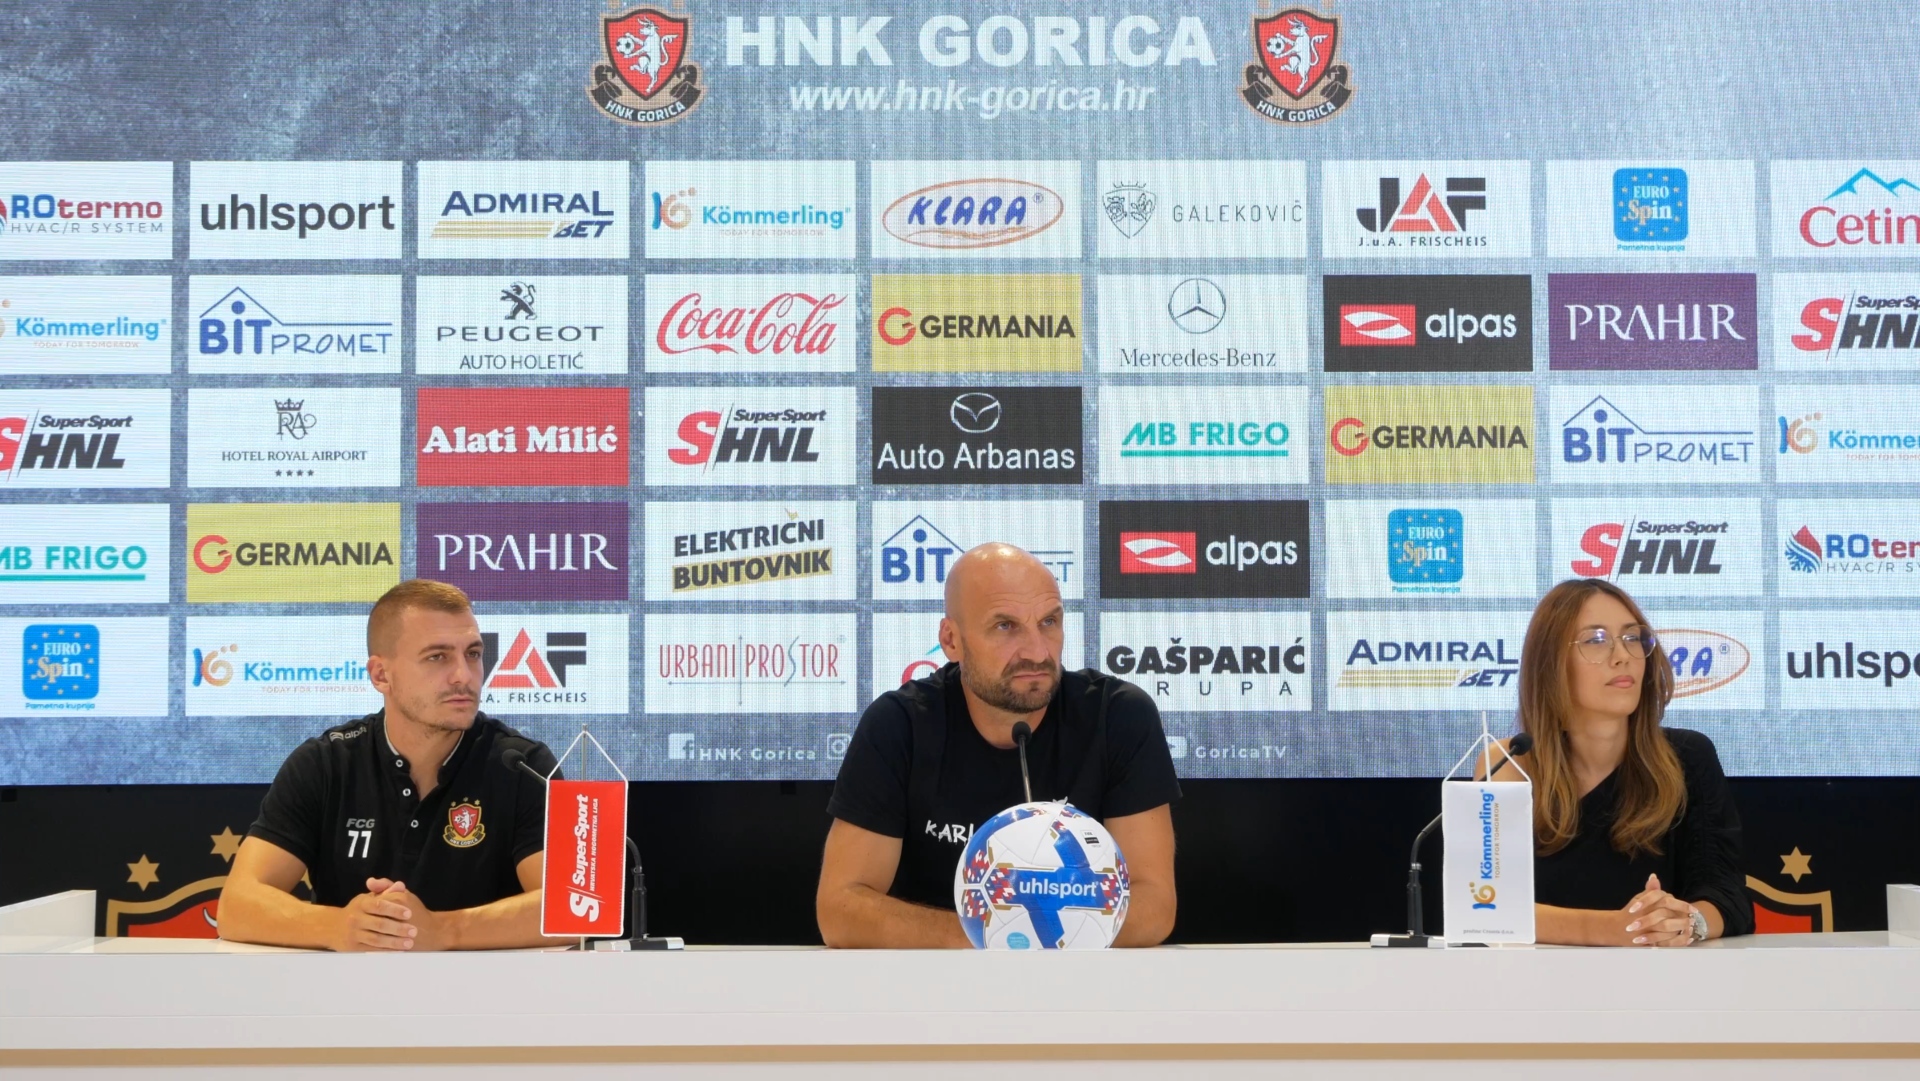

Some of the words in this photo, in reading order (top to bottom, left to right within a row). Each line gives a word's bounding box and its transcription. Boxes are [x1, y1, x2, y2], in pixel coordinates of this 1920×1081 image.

[726, 16, 894, 66] HNK
[919, 14, 1218, 67] GORICA
[604, 100, 635, 121] HNK
[637, 101, 686, 122] GORICA
[790, 79, 1156, 120] www.hnk-gorica.hr
[1256, 100, 1285, 120] HNK
[1288, 101, 1336, 122] GORICA
[441, 190, 615, 217] ADMIRAL
[1633, 185, 1670, 199] EURO
[11, 194, 162, 219] ROtermo
[201, 194, 395, 239] uhlsport
[702, 205, 844, 229] Kömmerling
[1627, 199, 1673, 226] Spin
[11, 222, 81, 234] HVAC/R
[91, 222, 163, 233] SYSTEM
[553, 220, 614, 238] BET
[1410, 236, 1487, 247] FRISCHEIS
[16, 317, 159, 340] Kömmerling
[437, 326, 604, 341] PEUGEOT
[919, 314, 1077, 338] GERMANIA
[1425, 308, 1517, 343] alpas
[1564, 303, 1746, 341] PRAHIR
[1838, 314, 1920, 349] HN
[460, 355, 507, 370] AUTO
[511, 351, 583, 370] HOLETIĆ
[1119, 348, 1276, 367] Mercedes-Benz
[39, 415, 133, 430] SuperSport
[733, 409, 826, 424] SuperSport
[422, 425, 517, 453] Alati
[526, 424, 618, 453] Milić
[1121, 422, 1177, 446] MB
[1189, 422, 1290, 446] FRIGO
[1372, 425, 1529, 449] GERMANIA
[1828, 430, 1920, 449] Kömme
[222, 451, 265, 461] HOTEL
[267, 451, 310, 461] ROYAL
[312, 450, 367, 461] AIRPORT
[876, 442, 945, 470] Auto
[953, 442, 1076, 470] Arbanas
[1408, 526, 1445, 540] EURO
[1635, 520, 1729, 535] SuperSport
[46, 545, 147, 570] FRIGO
[235, 541, 393, 566] GERMANIA
[433, 533, 618, 571] PRAHIR
[1205, 535, 1298, 571] alpas
[1402, 540, 1447, 567] Spin
[673, 549, 830, 590] BUNTOVNIK
[1827, 562, 1894, 574] HVAC/R
[44, 642, 81, 656] EURO
[659, 644, 736, 678] URBANI
[1106, 637, 1305, 675] GAŠPARIĆ
[1346, 639, 1519, 665] ADMIRAL
[36, 656, 84, 683] Spin
[244, 661, 369, 681] Kömmerlin
[1787, 642, 1920, 687] uhlsp
[1458, 669, 1519, 687] BET
[509, 692, 587, 703] FRISCHEIS
[700, 748, 742, 761] HNK
[750, 746, 816, 761] Gorica
[346, 818, 375, 829] FCG
[348, 830, 372, 858] 77
[572, 793, 590, 887] SuperSport
[1479, 793, 1495, 879] Kömmerling
[1019, 878, 1097, 898] uhlsport
